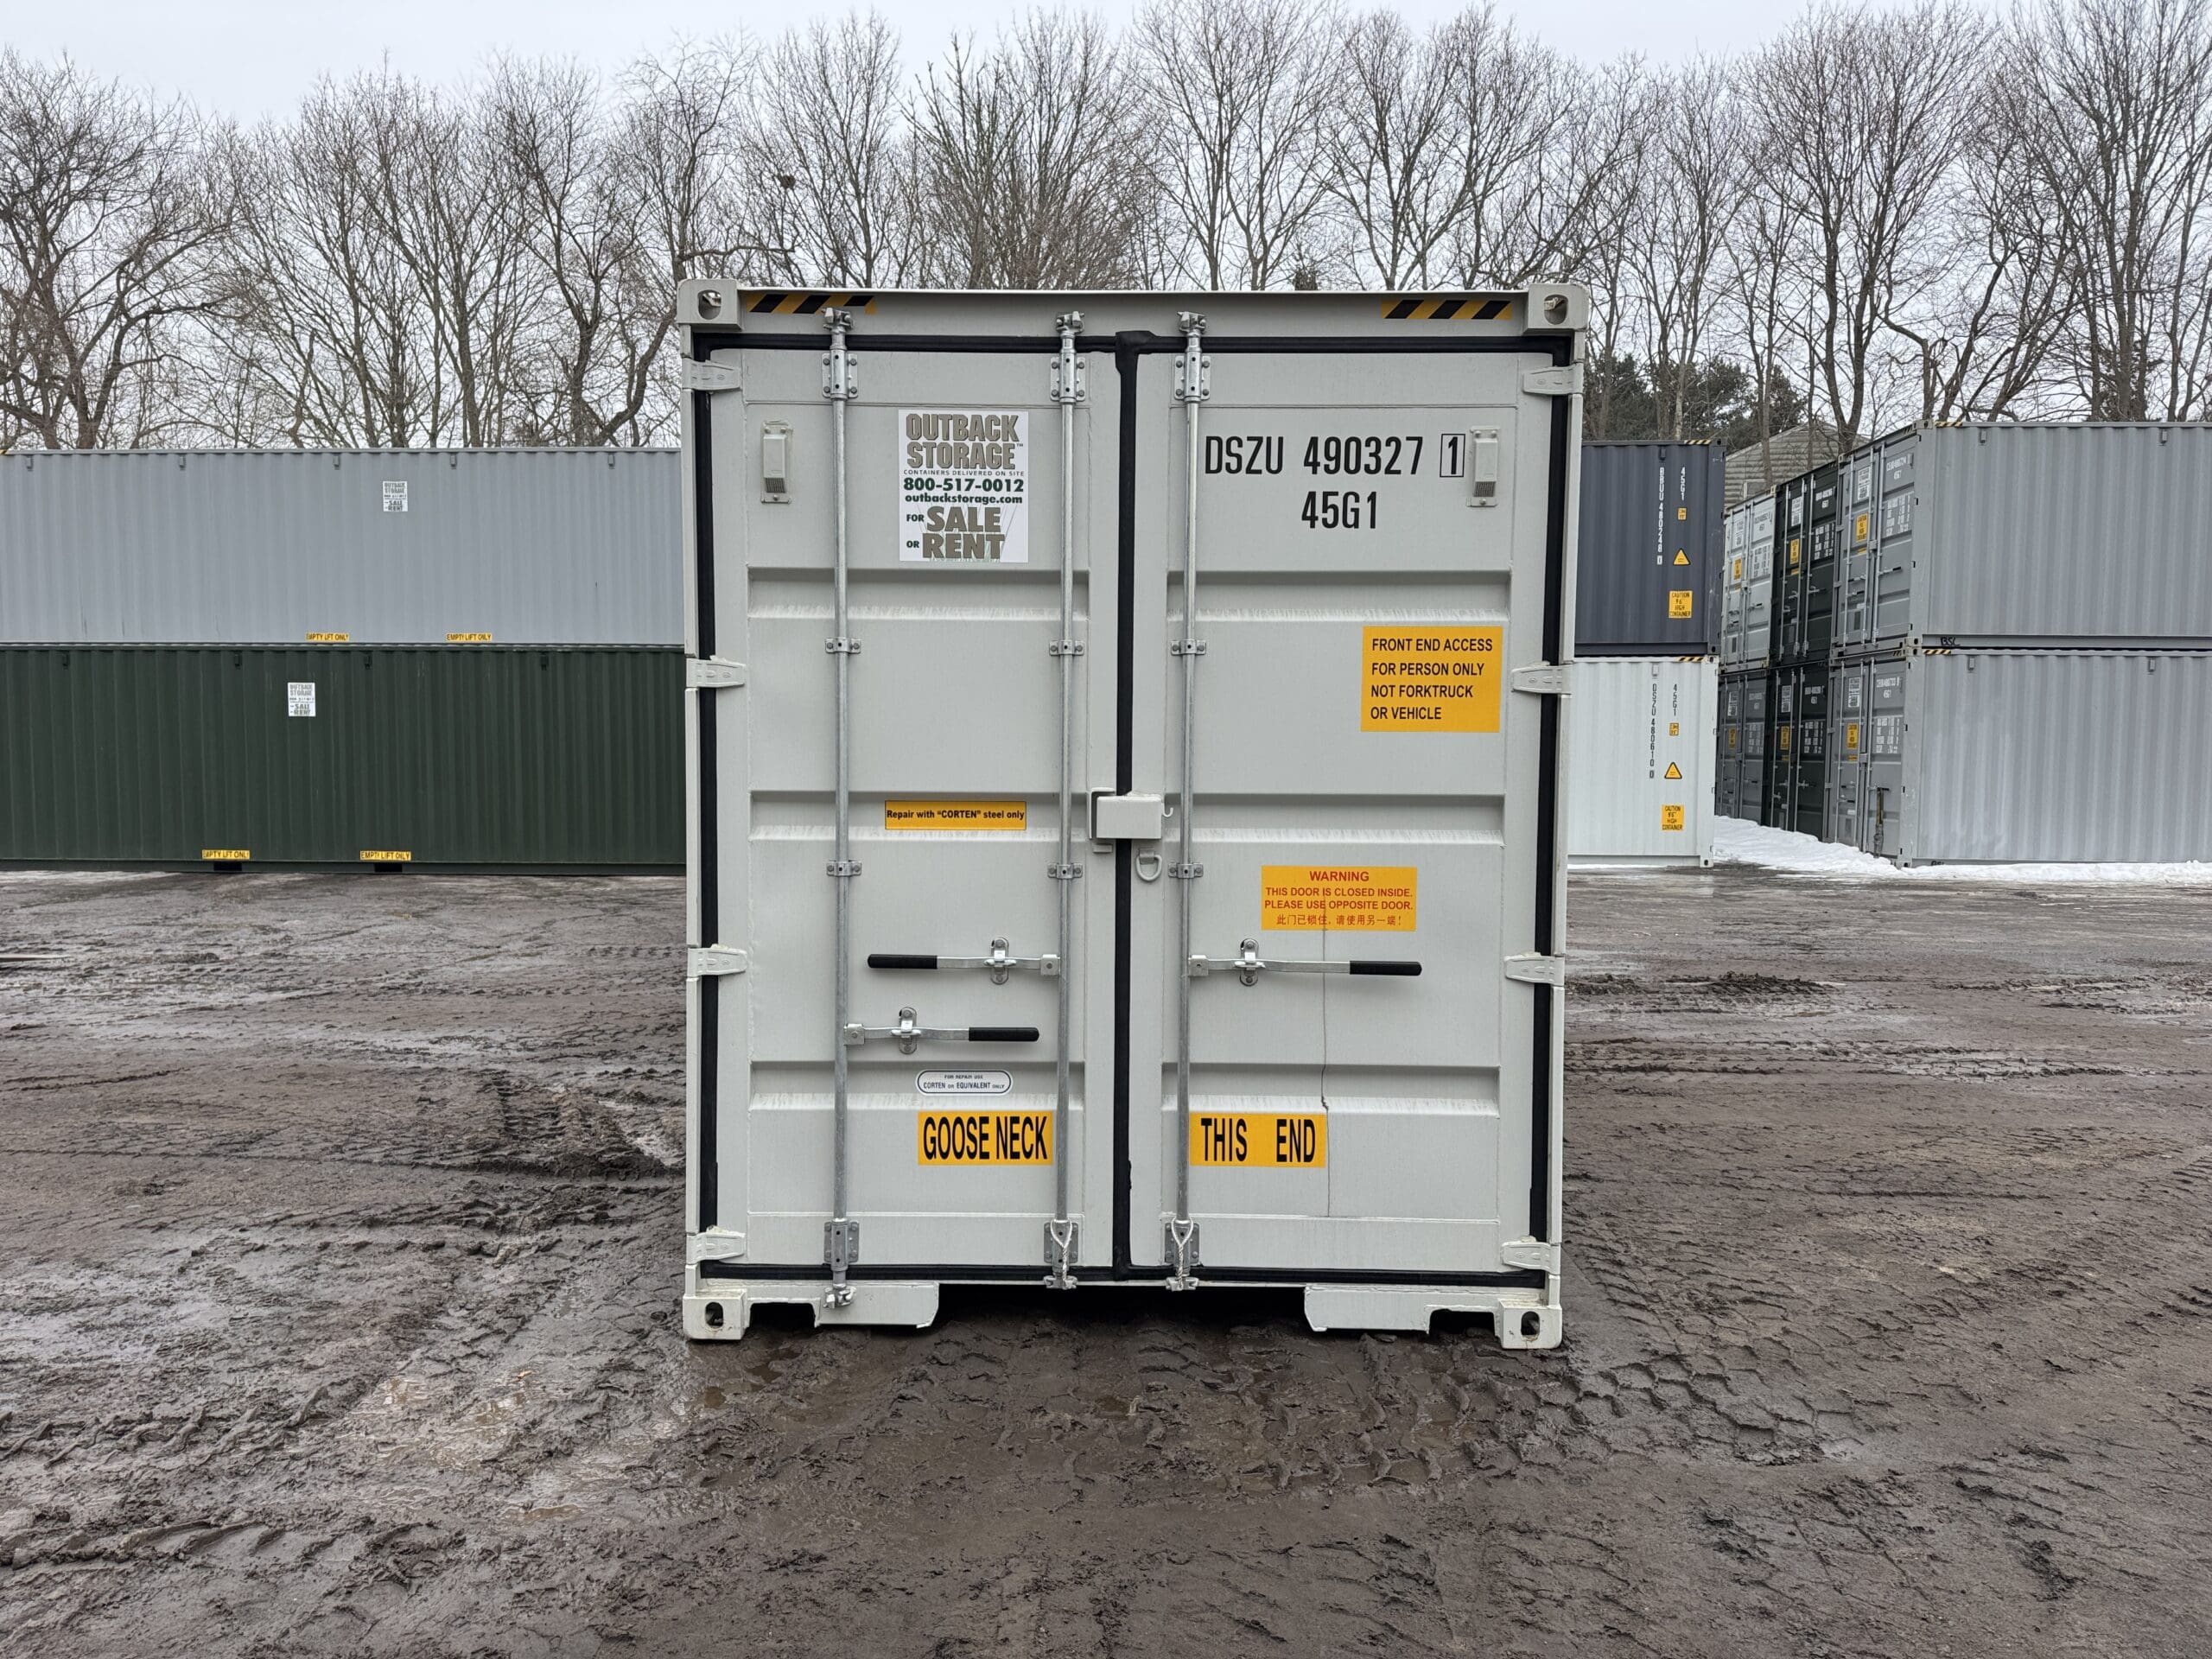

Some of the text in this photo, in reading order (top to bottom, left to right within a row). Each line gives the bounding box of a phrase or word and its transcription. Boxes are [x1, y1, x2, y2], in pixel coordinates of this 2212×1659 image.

[906, 413, 1019, 442] OUTBACK
[907, 442, 1016, 469] STORAGE
[1205, 436, 1458, 475] DSZU 490327 1
[904, 478, 1024, 492] 800-517-0012
[905, 493, 1022, 505] outbackstorage.com
[1301, 491, 1377, 529] 45G1
[927, 506, 1001, 532] SALE
[922, 533, 1005, 559] RENT
[1372, 638, 1492, 651] FRONT END ACCESS
[1372, 663, 1484, 676] FOR PERSON ONLY
[1371, 685, 1473, 697] NOT FORKTRUCK
[1371, 707, 1442, 719] OR VEHICLE
[887, 810, 914, 820] Repair
[1007, 810, 1024, 820] only
[1309, 871, 1369, 881] WARNING
[1266, 887, 1413, 897] THIS DOOR IS CLOSED INSIDE.
[1265, 900, 1413, 910] PLEASE USE OPPOSITE DOOR.
[924, 1116, 1047, 1160] GOOSE NECK
[1201, 1118, 1315, 1163] THIS END
